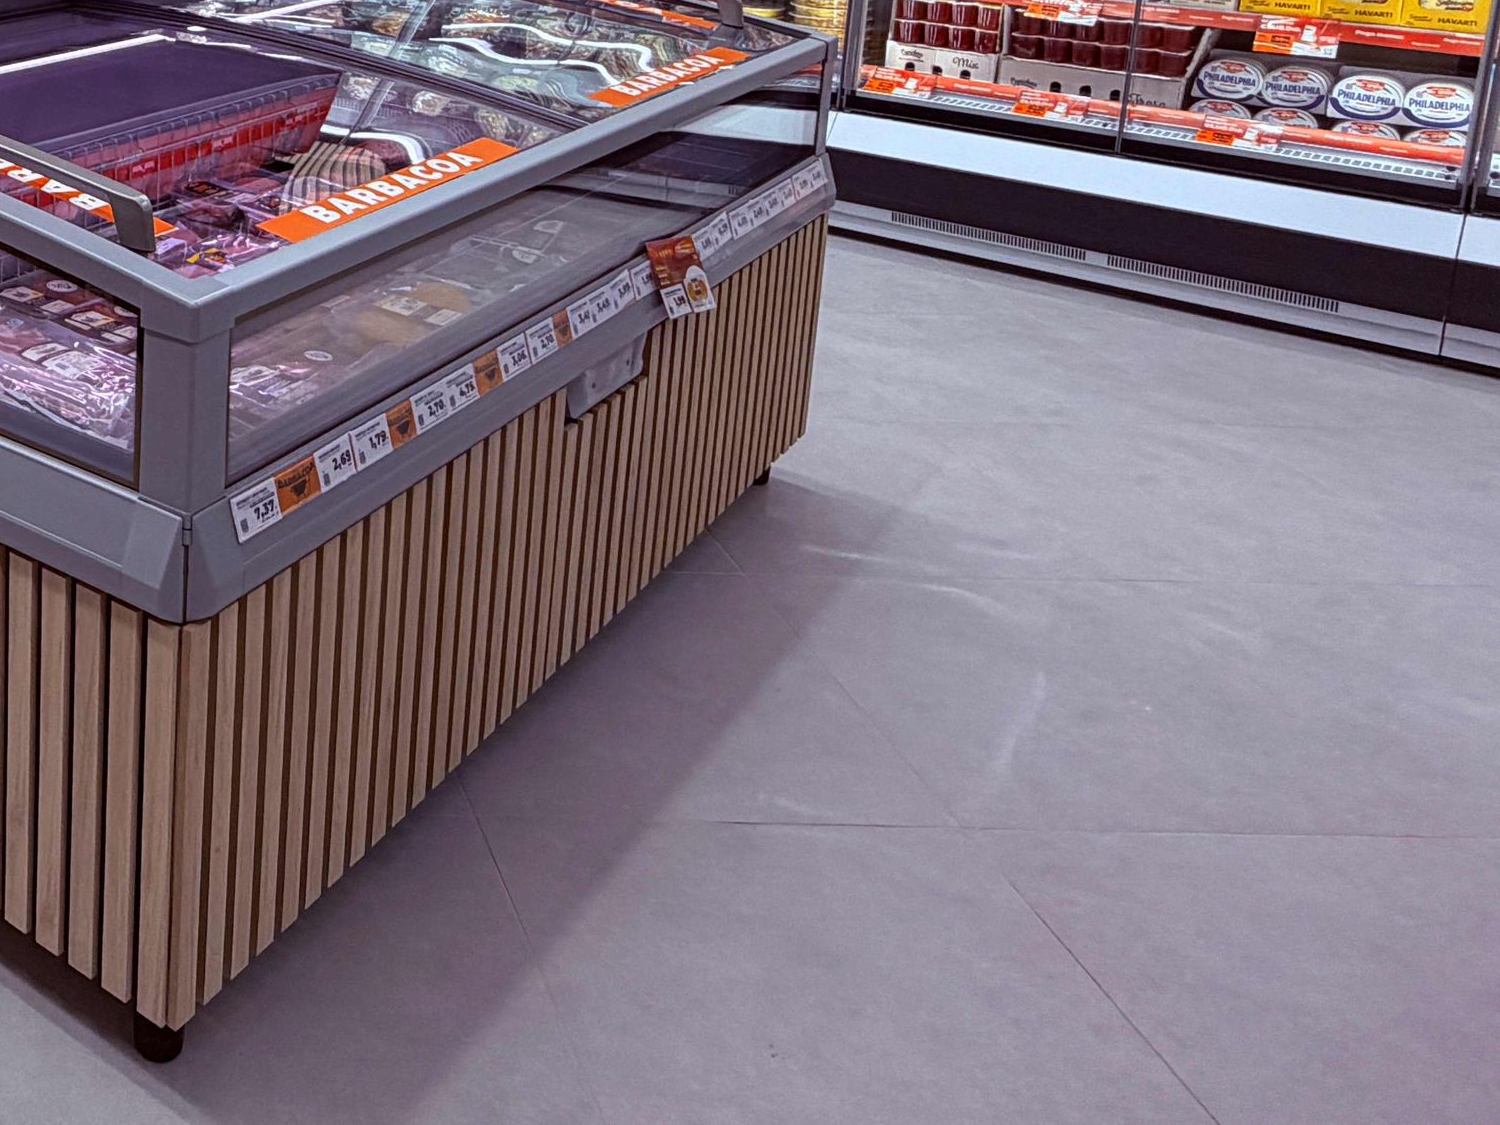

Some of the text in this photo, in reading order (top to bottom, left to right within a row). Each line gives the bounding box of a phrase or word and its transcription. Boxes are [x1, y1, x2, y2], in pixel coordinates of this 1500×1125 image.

[1274, 1, 1311, 11] HAVARTI
[1354, 8, 1394, 19] HAVARTI
[1437, 17, 1478, 27] HAVARTI
[952, 56, 980, 70] Mix
[609, 54, 725, 97] BARBACOA
[1202, 71, 1256, 88] PHILADELPHIA
[1265, 81, 1322, 96] PHILADELPHIA
[1337, 89, 1397, 107] PHILADELPHIA
[1408, 97, 1471, 113] PHILADELPHIA
[299, 152, 484, 224] BARBACOA
[368, 429, 387, 450] 1,79
[331, 448, 351, 471] 2,69
[253, 498, 276, 521] 7,37
